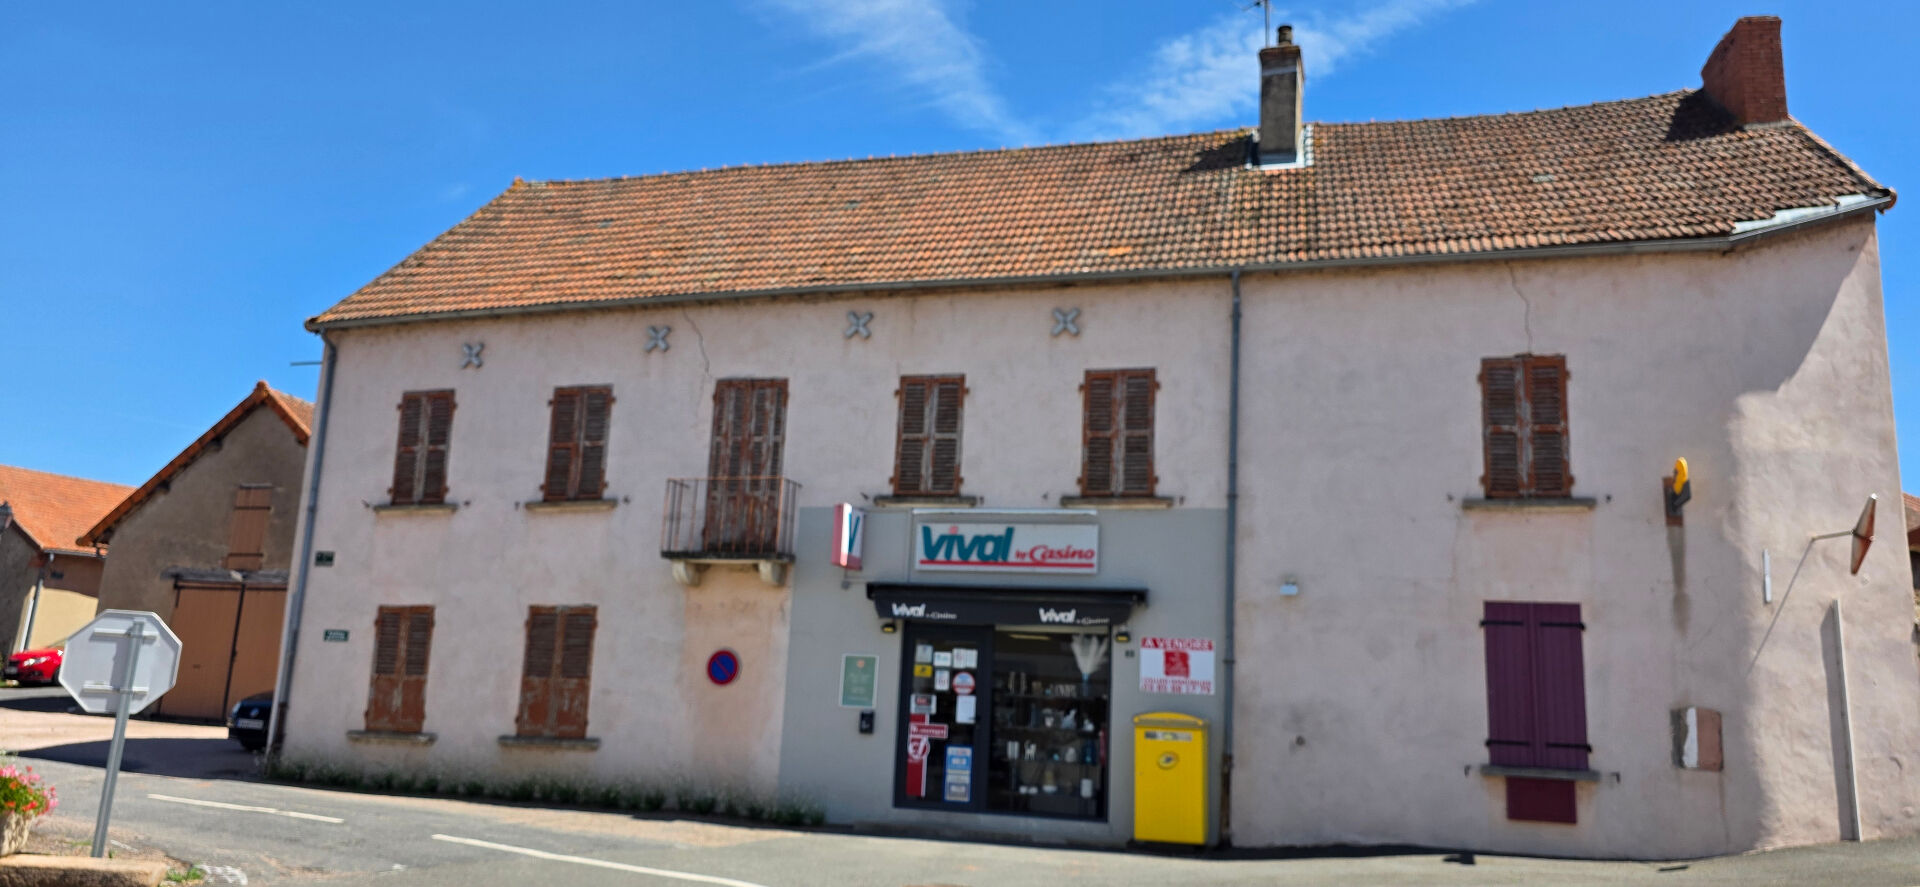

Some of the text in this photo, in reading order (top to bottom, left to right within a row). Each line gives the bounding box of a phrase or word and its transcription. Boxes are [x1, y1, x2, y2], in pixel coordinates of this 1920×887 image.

[922, 525, 1015, 562] Vival
[1029, 544, 1095, 562] Casino
[891, 602, 927, 617] Vival
[1038, 607, 1077, 623] Vival
